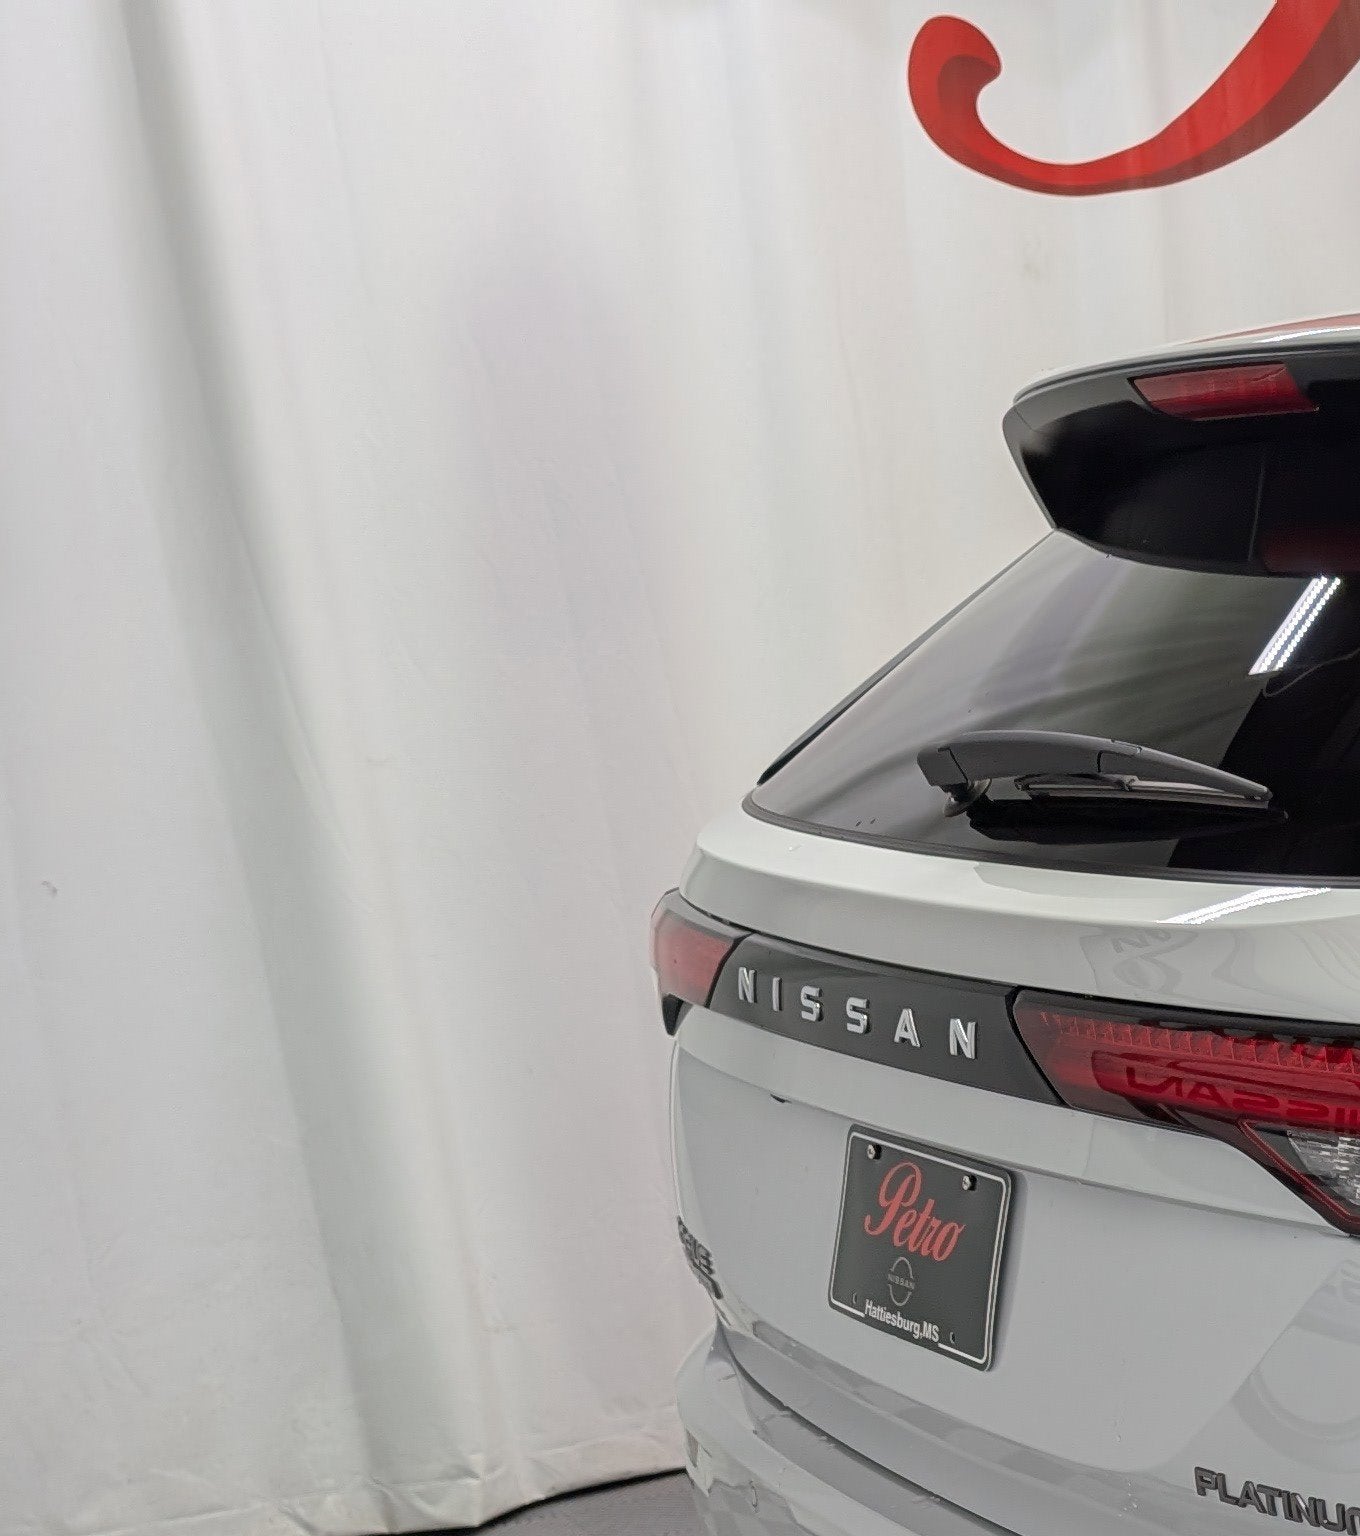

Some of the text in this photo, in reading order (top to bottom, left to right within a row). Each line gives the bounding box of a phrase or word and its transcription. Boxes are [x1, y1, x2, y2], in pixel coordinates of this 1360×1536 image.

[738, 966, 978, 1060] NISSAN
[864, 1160, 967, 1262] Petro
[887, 1273, 916, 1290] NISSAN
